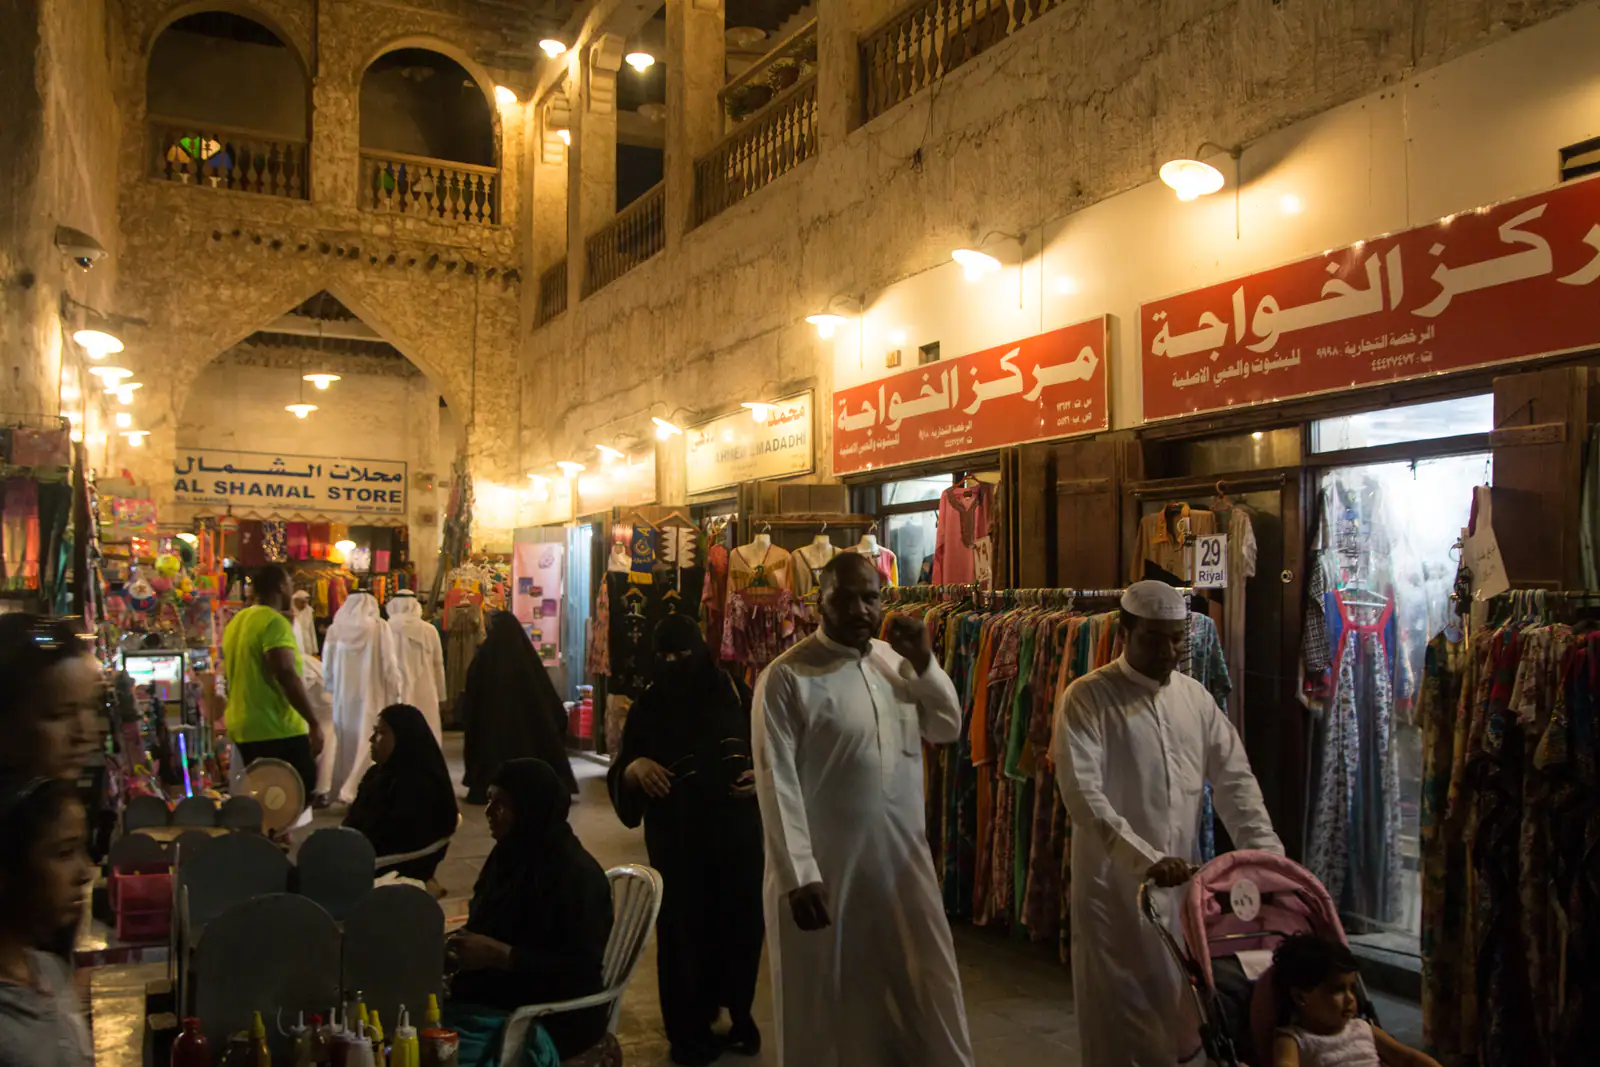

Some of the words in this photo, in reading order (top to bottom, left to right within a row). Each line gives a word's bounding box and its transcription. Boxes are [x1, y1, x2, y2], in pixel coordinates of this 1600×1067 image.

[1410, 202, 1600, 318] ركز
[1150, 243, 1405, 364] الخواجة
[1389, 324, 1435, 346] الرخصة
[963, 343, 1099, 415] مركز
[837, 363, 960, 437] الخواجة
[174, 456, 322, 478] الشمال
[330, 463, 402, 483] محلات
[174, 479, 204, 494] AL
[214, 480, 315, 499] SHAMAL
[328, 486, 402, 503] STORE
[1201, 539, 1220, 566] 29
[1199, 570, 1224, 584] Riyal
